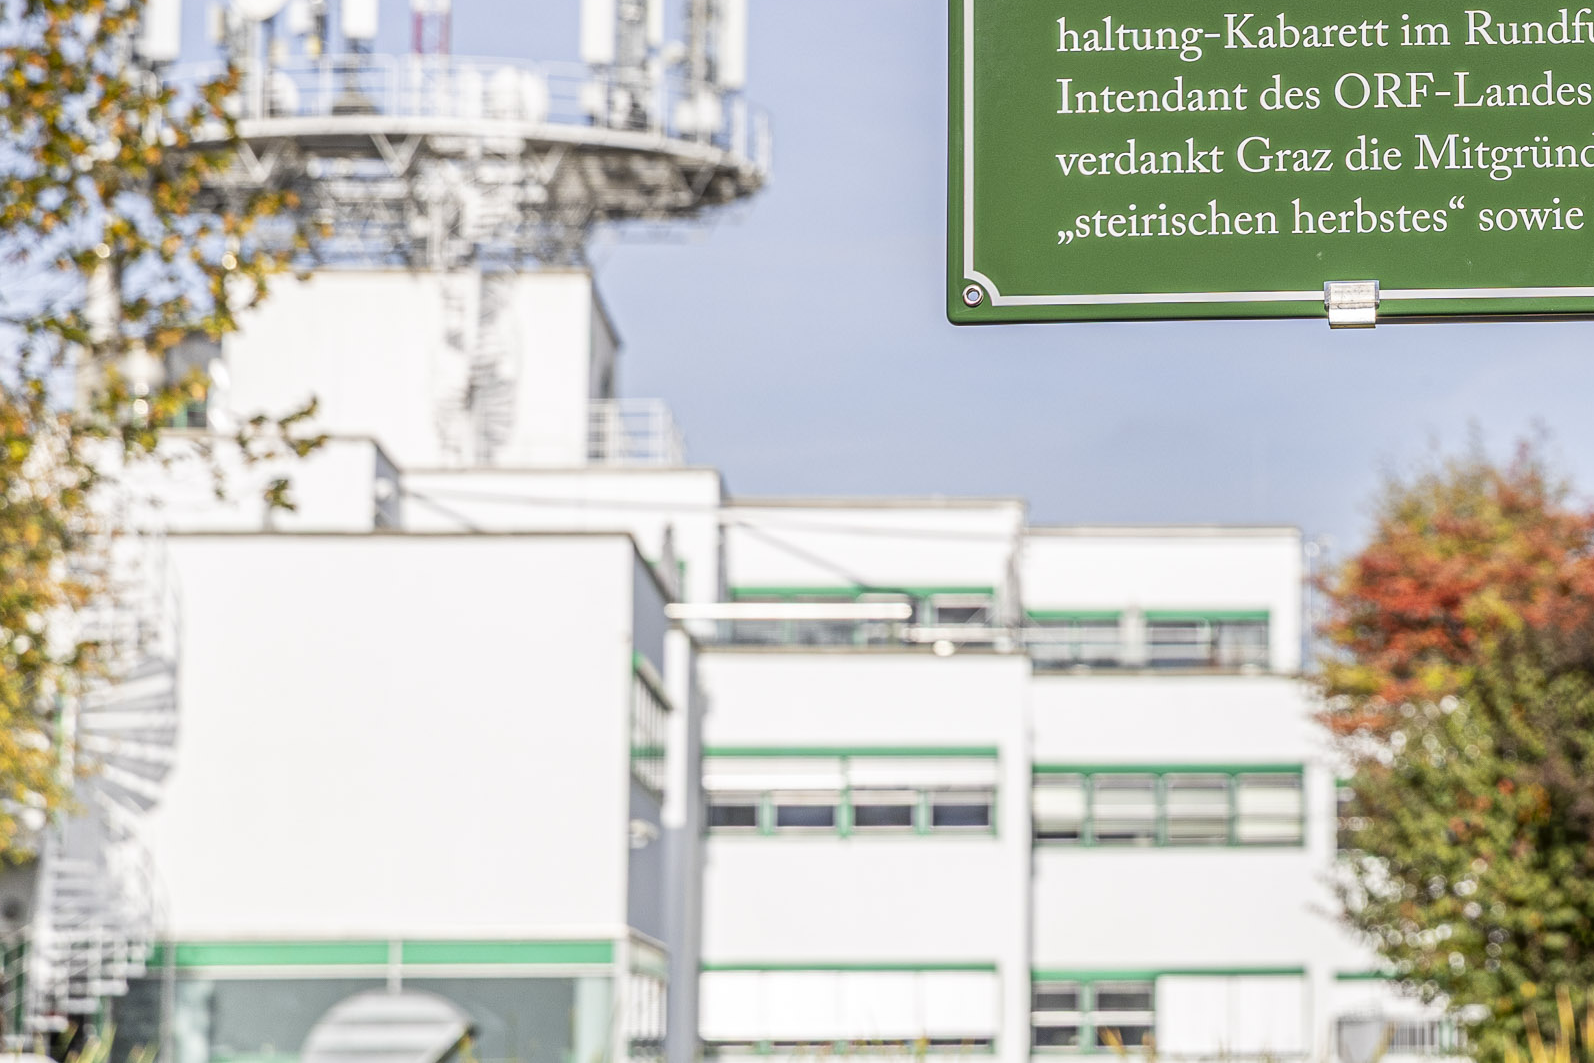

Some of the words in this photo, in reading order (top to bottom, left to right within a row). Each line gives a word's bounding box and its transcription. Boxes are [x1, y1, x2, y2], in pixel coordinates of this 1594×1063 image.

[1056, 12, 1390, 62] haltung-Kabarett
[1400, 13, 1452, 46] im
[1055, 75, 1248, 114] Intendant
[1259, 73, 1321, 111] des
[1055, 137, 1225, 177] verdankt
[1236, 136, 1334, 173] Graz
[1345, 134, 1403, 171] die
[1057, 198, 1280, 245] „steirischen
[1291, 195, 1465, 234] herbstes“
[1478, 197, 1585, 232] sowie
